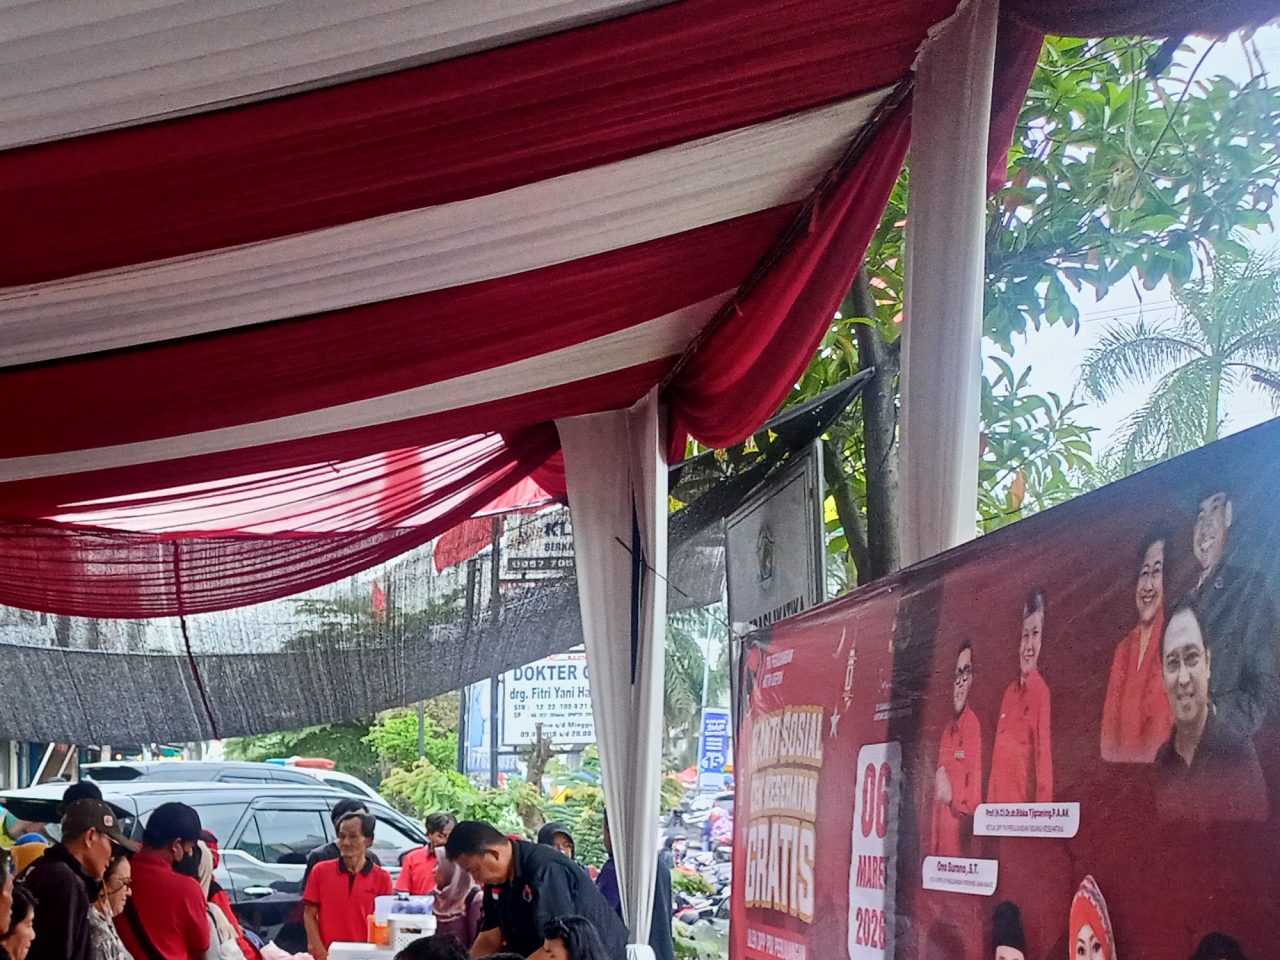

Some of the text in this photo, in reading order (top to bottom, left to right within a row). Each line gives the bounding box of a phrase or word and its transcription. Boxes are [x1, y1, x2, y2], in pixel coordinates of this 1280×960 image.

[510, 687, 529, 702] drg.
[531, 686, 551, 699] Fitri
[554, 686, 575, 701] Yani
[513, 664, 577, 681] DOKTER
[780, 707, 824, 764] SOSIAL
[861, 762, 892, 839] 06
[745, 819, 816, 922] GRATIS
